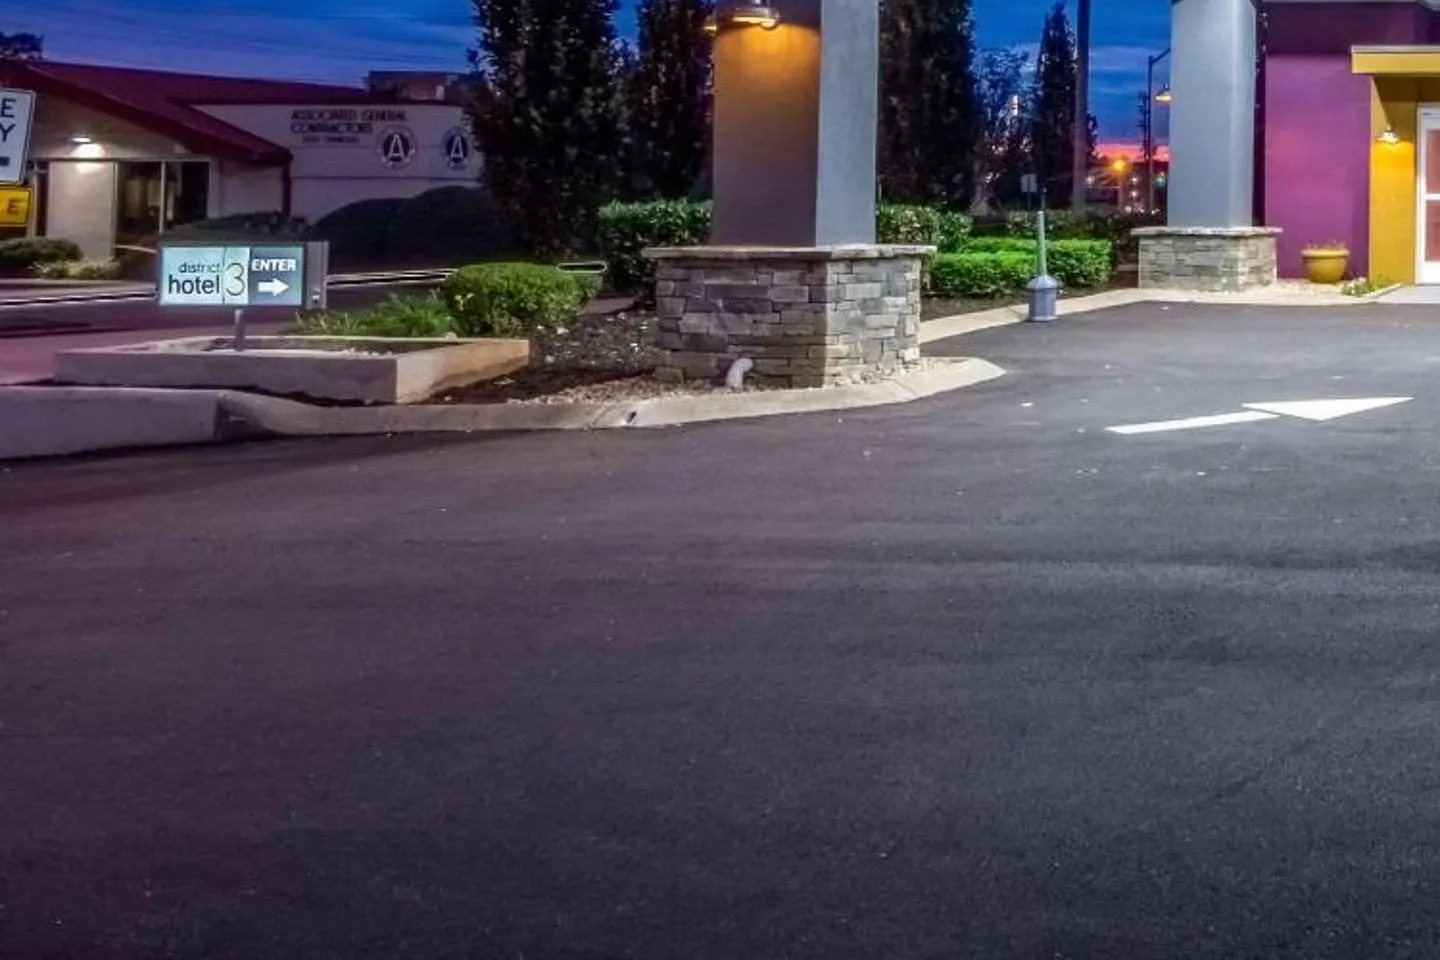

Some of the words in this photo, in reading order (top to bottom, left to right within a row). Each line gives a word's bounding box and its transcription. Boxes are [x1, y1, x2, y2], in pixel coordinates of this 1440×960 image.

[178, 260, 221, 273] district
[251, 258, 297, 271] ENTER
[168, 274, 220, 295] hotel
[226, 262, 246, 297] 3
